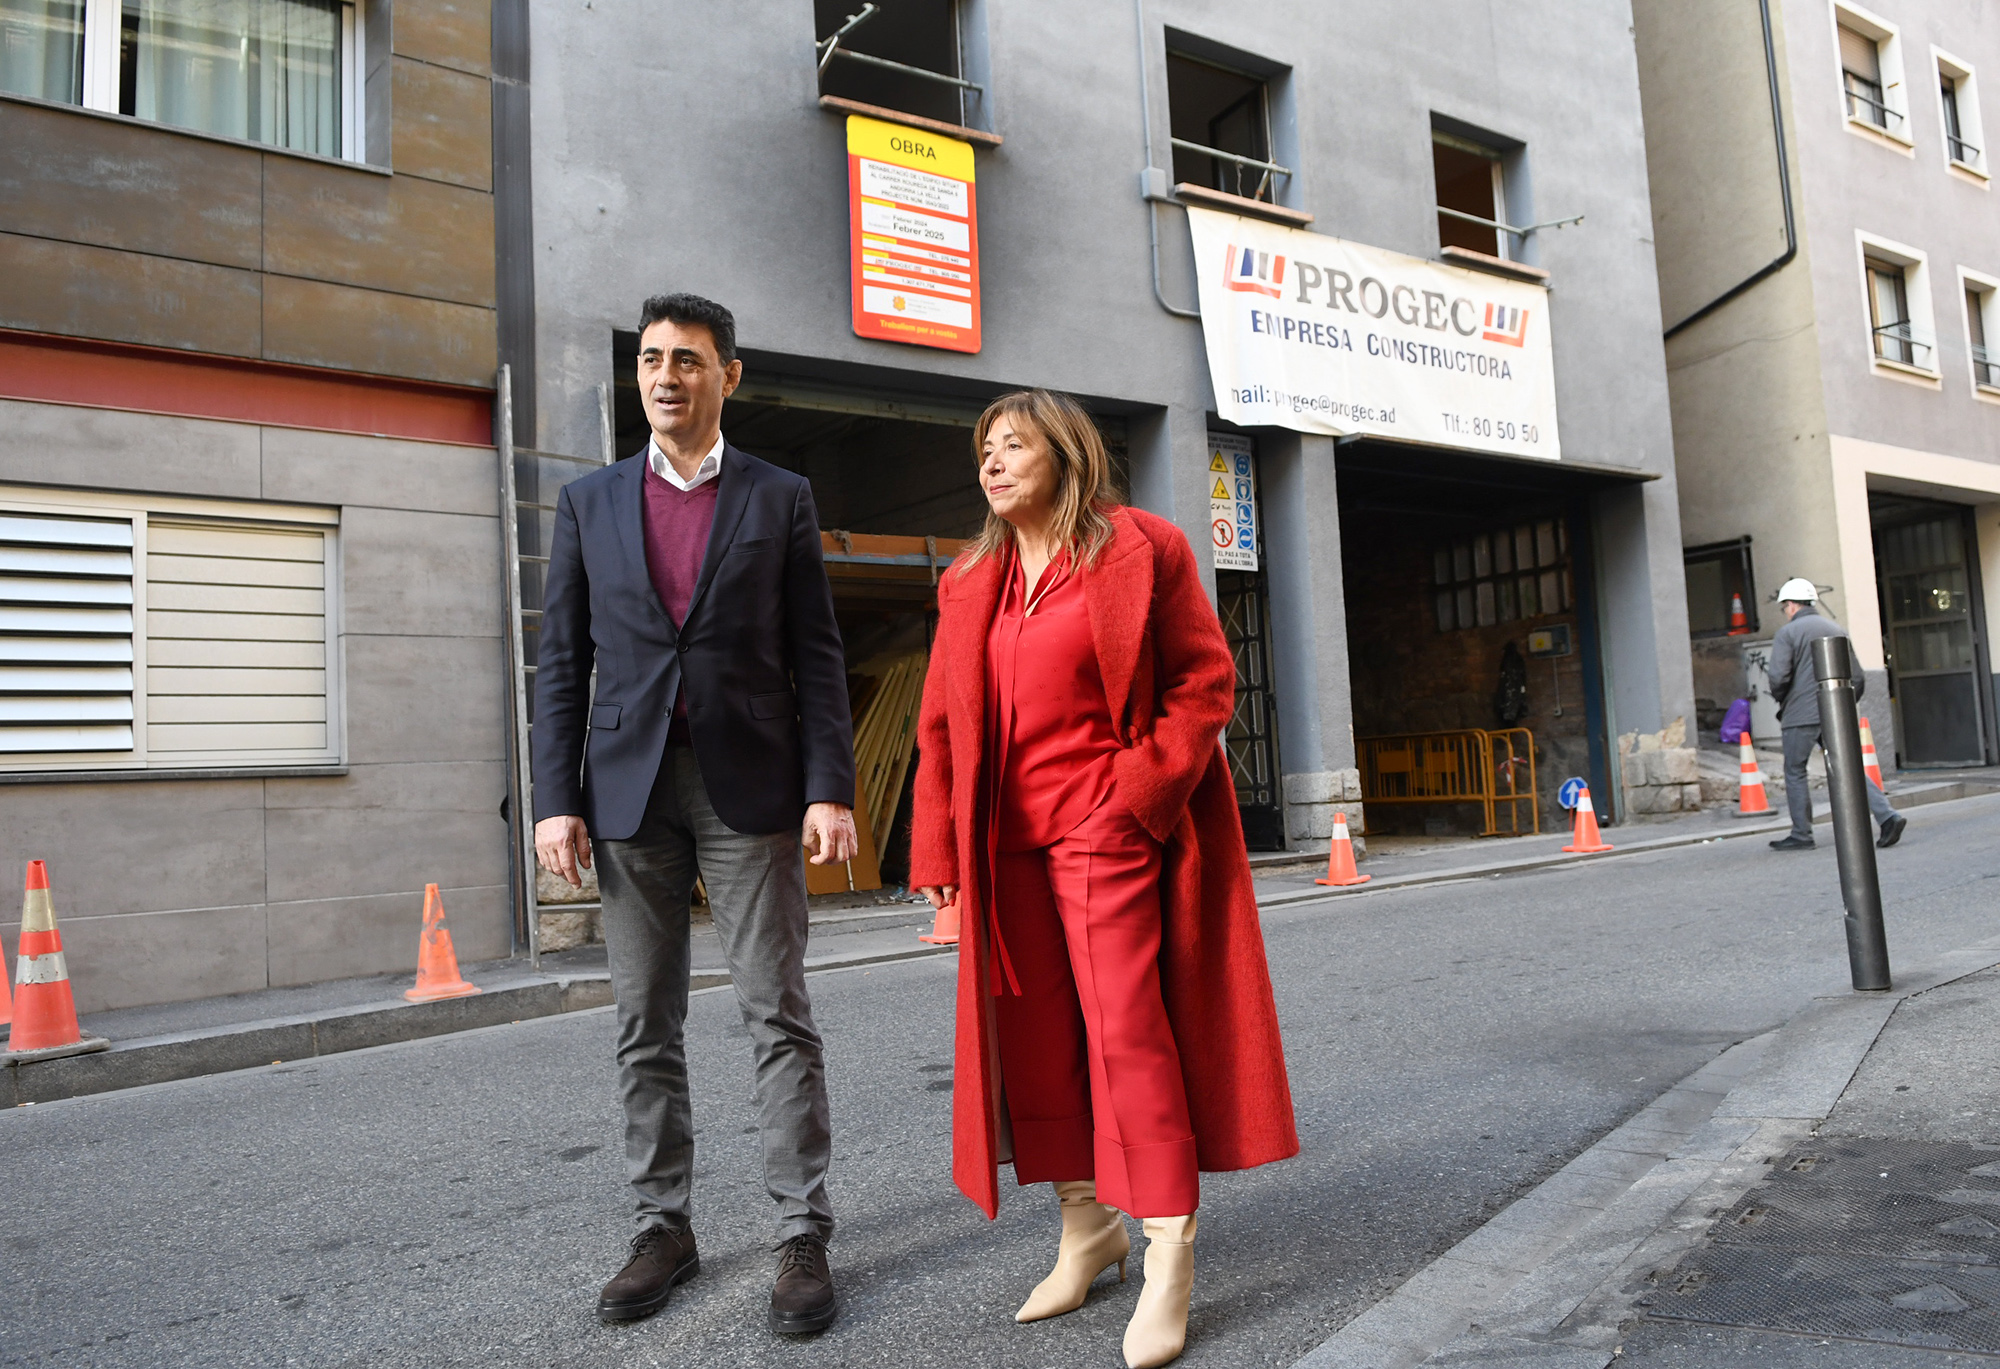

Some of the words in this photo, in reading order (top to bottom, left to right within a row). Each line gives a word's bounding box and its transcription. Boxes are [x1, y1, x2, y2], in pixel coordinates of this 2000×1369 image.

[890, 137, 937, 160] OBRA
[893, 222, 922, 235] Febrer
[924, 229, 945, 241] 2025
[1294, 260, 1477, 337] PROGEC
[1251, 309, 1353, 352] EMPRESA
[1366, 333, 1513, 381] CONSTRUCTORA
[1473, 416, 1491, 437] 80
[1497, 420, 1516, 441] 50
[1522, 424, 1539, 444] 50
